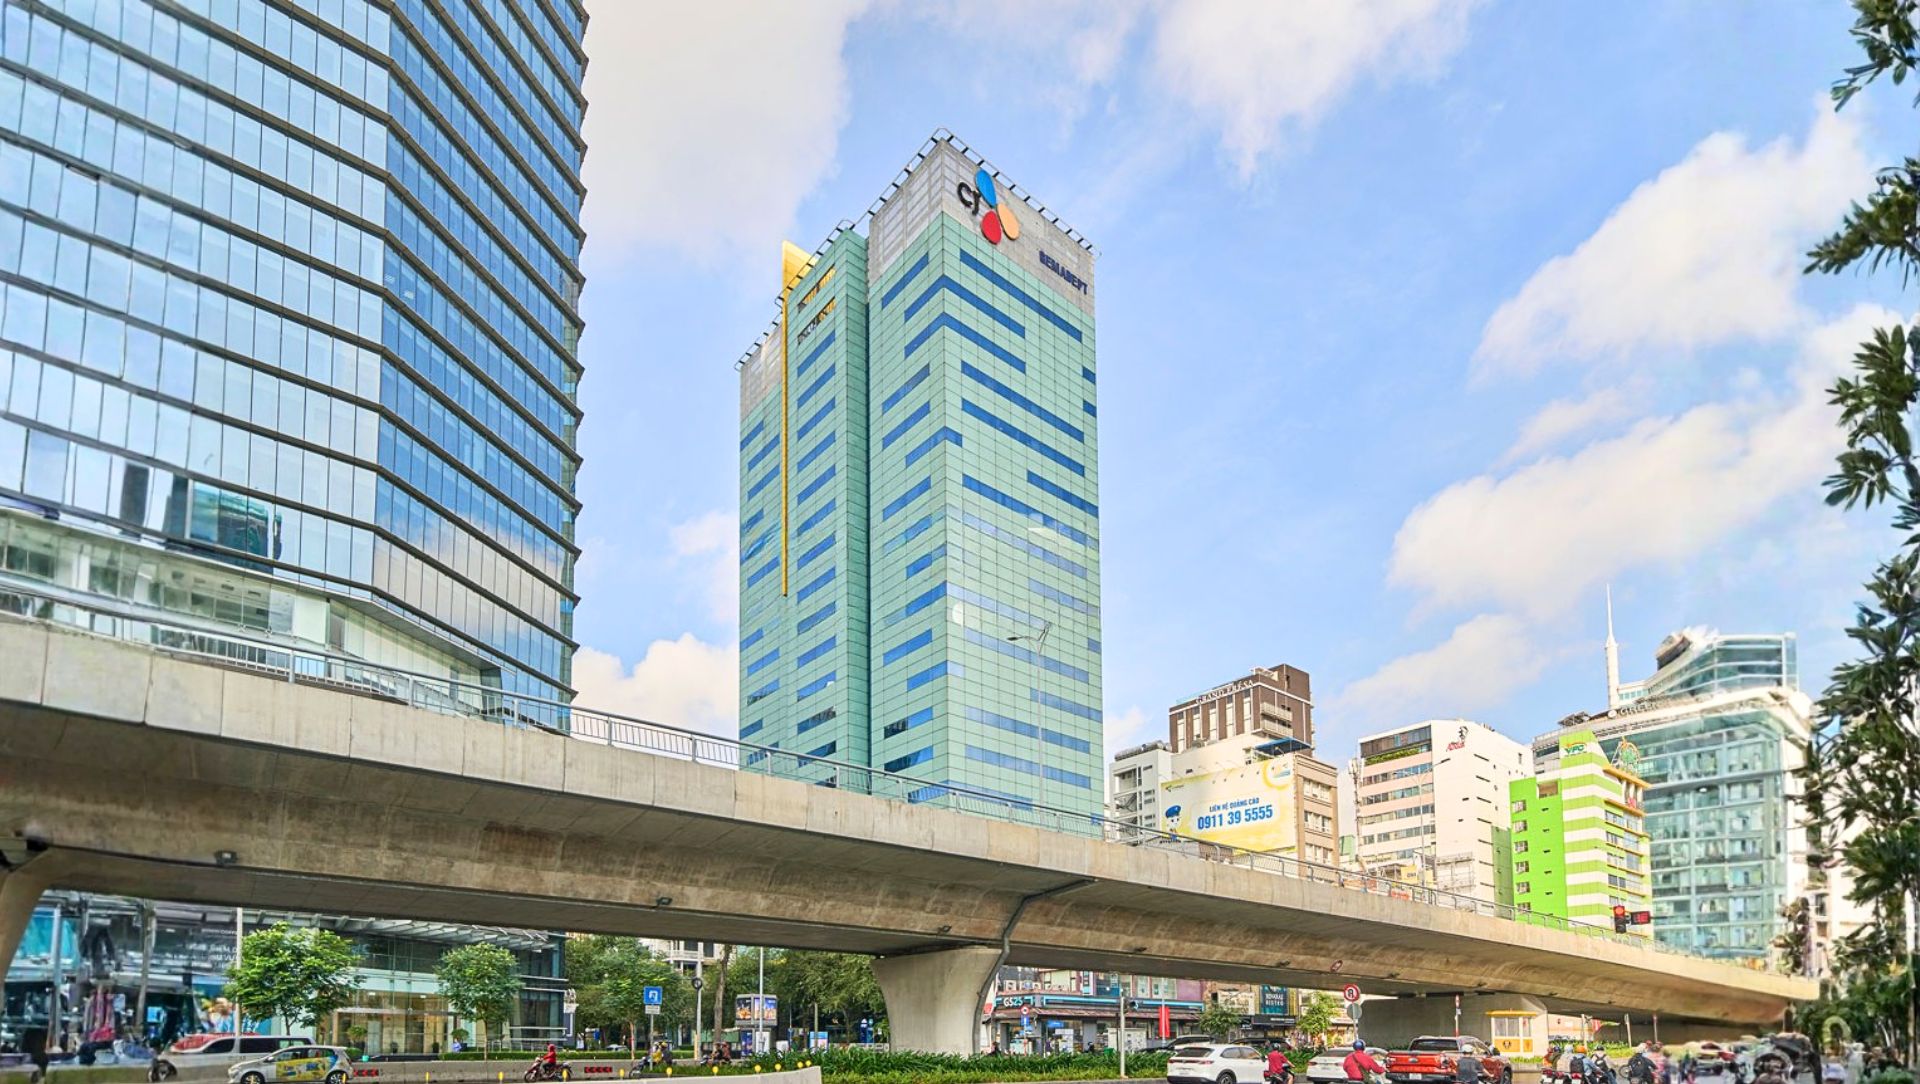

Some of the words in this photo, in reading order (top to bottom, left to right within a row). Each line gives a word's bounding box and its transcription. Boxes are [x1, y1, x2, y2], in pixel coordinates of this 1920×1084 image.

[1197, 813, 1223, 830] 0911
[1227, 810, 1241, 825] 39
[1244, 804, 1273, 822] 5555
[1003, 996, 1024, 1008] GS25
